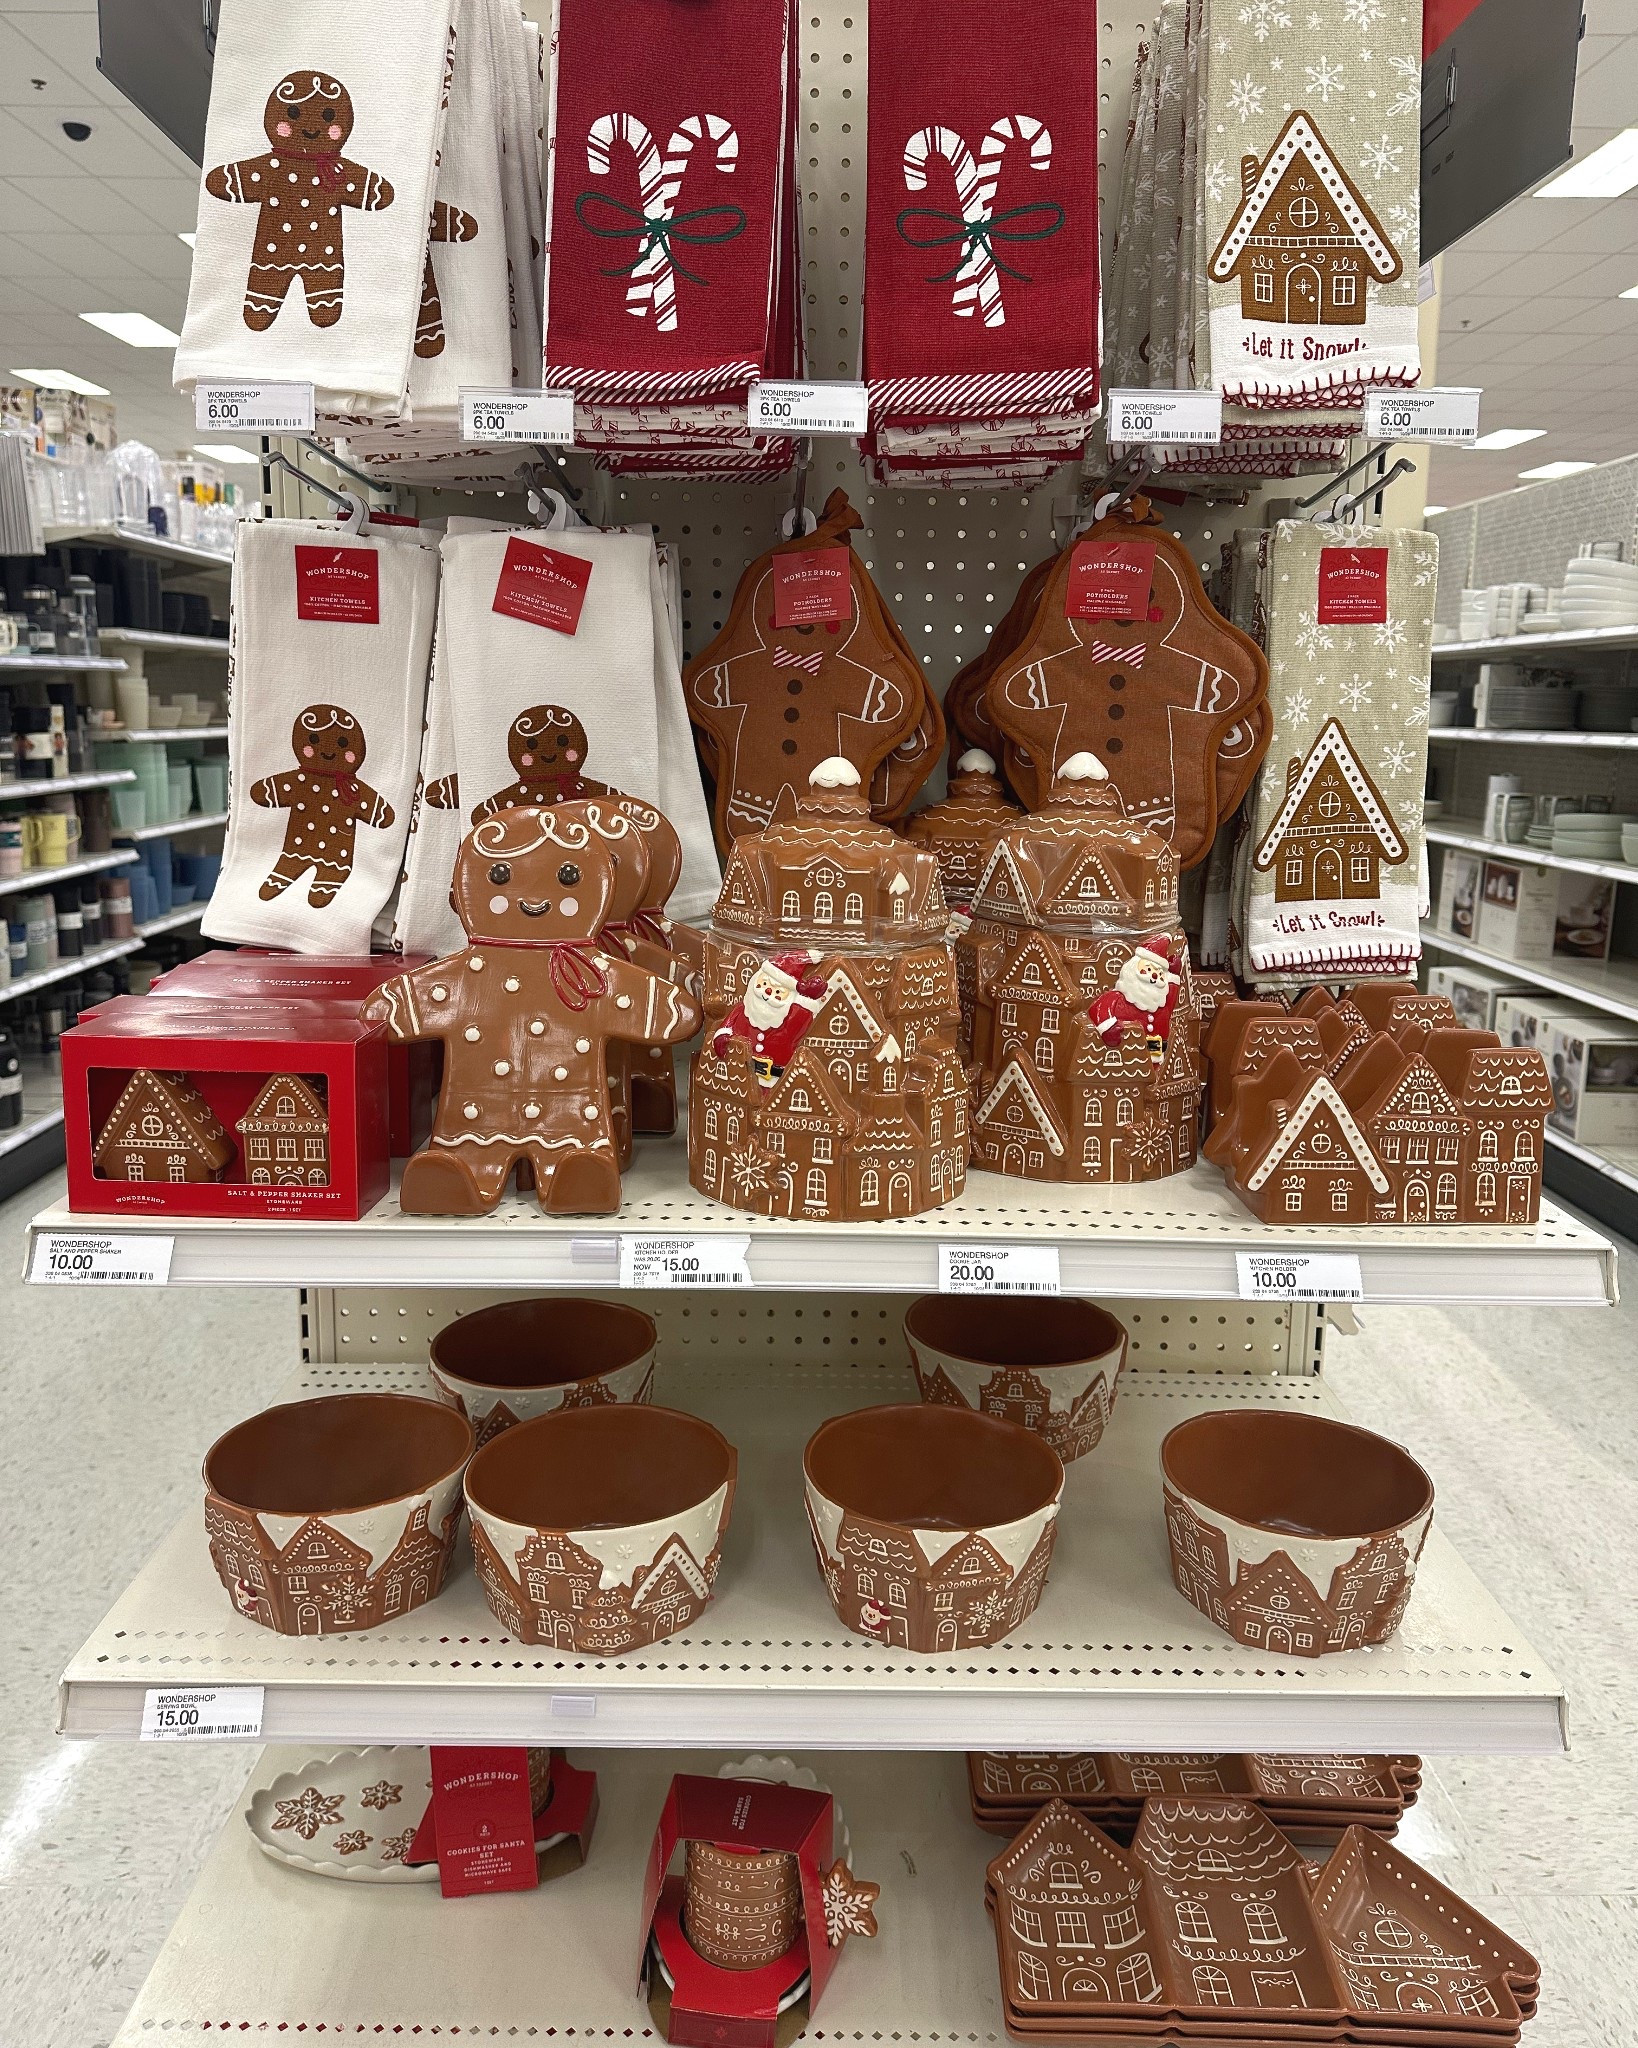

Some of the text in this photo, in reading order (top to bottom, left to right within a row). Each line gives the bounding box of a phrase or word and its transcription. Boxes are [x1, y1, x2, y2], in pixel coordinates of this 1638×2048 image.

[1252, 332, 1272, 358] Let
[1280, 338, 1294, 360] it
[760, 390, 814, 398] WONDERSHOP
[208, 404, 238, 418] 6.00
[472, 402, 528, 410] WONDERSHOP
[760, 402, 791, 416] 6.00
[1380, 400, 1434, 408] WONDERSHOP
[474, 416, 505, 430] 6.00
[1122, 416, 1153, 430] 6.00
[1380, 412, 1411, 426] 6.00
[306, 568, 370, 580] WONDERSHOP
[1078, 562, 1144, 574] WONDERSHOP
[1327, 568, 1380, 579] WONDERSHOP
[512, 564, 578, 590] WONDERSHOP
[782, 570, 842, 584] WONDERSHOP
[510, 590, 540, 604] KITCHEN
[542, 600, 568, 613] TOWELS
[1280, 914, 1305, 934] Let
[1309, 914, 1326, 930] it
[116, 1196, 166, 1204] WONDERSHOP
[50, 1240, 112, 1248] WONDERSHOP
[634, 1242, 694, 1250] WONDERSHOP
[49, 1254, 93, 1270] 10.00
[949, 1251, 1008, 1260] WONDERSHOP
[1248, 1258, 1310, 1266] WONDERSHOP
[662, 1258, 700, 1272] 15.00
[950, 1265, 994, 1281] 20.00
[1252, 1272, 1296, 1288] 10.00
[158, 1694, 216, 1704] WONDERSHOP
[156, 1710, 199, 1726] 15.00
[443, 1772, 519, 1791] WONDERSHOP
[482, 1824, 488, 1832] 2
[447, 1846, 480, 1856] COOKIES
[500, 1840, 525, 1848] SANTA
